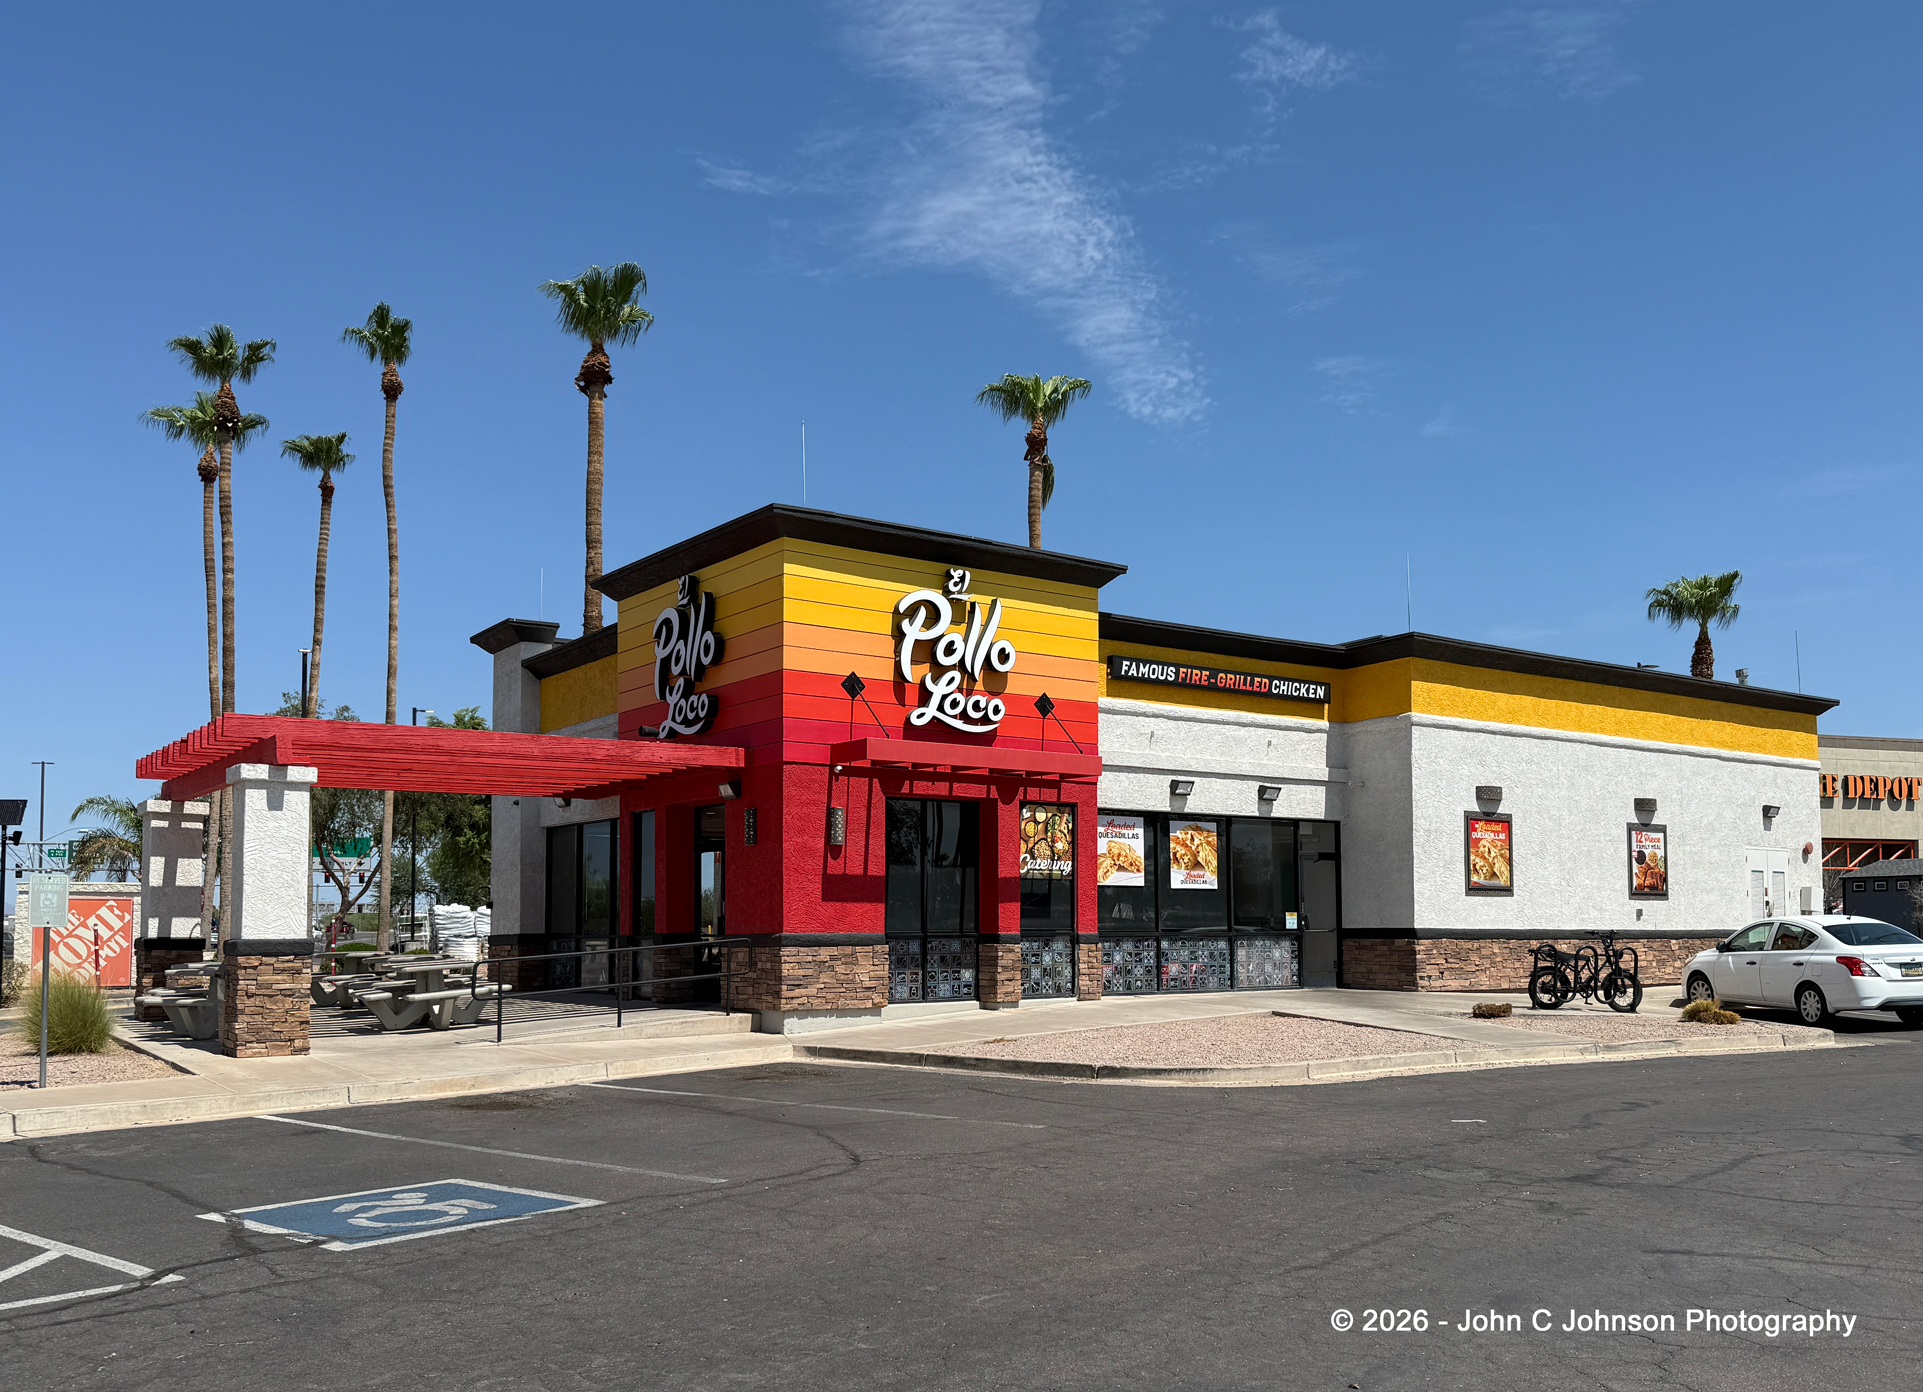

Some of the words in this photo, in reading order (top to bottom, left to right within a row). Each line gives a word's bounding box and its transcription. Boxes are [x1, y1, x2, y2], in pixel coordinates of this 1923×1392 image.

[653, 591, 715, 700] Pollo
[899, 590, 1016, 684] Pollo
[1121, 660, 1176, 681] FAMOUS
[1178, 667, 1270, 693] FIRE-GRILLED
[1271, 680, 1325, 699] CHICKEN
[659, 677, 709, 739] Loco
[910, 670, 1006, 733] Loco
[1845, 775, 1922, 801] DEPOT
[1104, 818, 1136, 833] Loaded
[1477, 820, 1503, 833] Loaded
[1098, 831, 1140, 840] QUESADILLAS
[1471, 831, 1506, 840] QUESADILLAS
[1634, 831, 1644, 844] 12
[1643, 833, 1661, 845] Piece
[1019, 853, 1073, 876] Catering
[32, 876, 67, 885] RESERVED
[1184, 870, 1206, 880] Loaded
